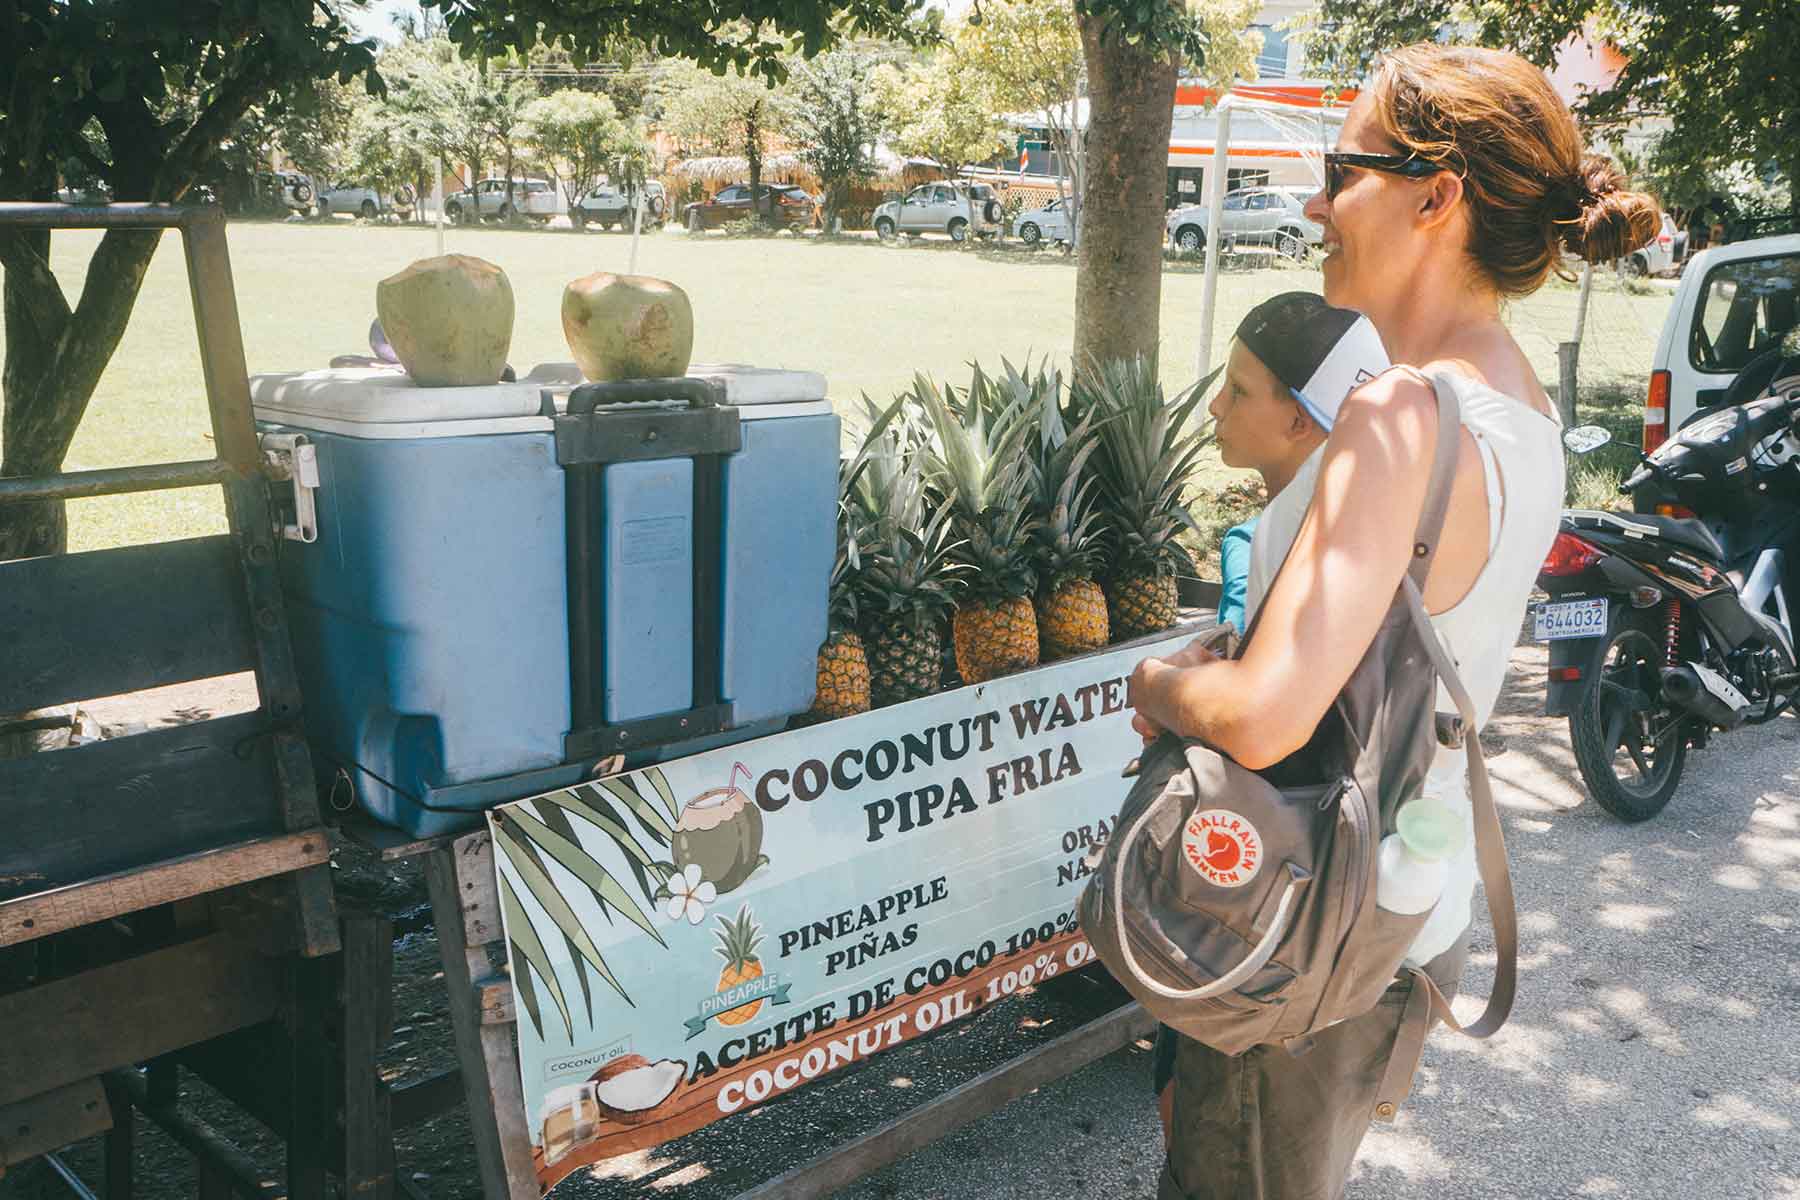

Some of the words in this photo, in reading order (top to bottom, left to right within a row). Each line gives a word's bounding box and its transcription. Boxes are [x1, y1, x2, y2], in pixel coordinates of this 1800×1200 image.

[1545, 608, 1602, 630] 644032
[755, 711, 999, 812] COCONUT
[864, 777, 978, 842] PIPA
[986, 742, 1083, 805] FRIA
[1057, 856, 1096, 887] NA
[778, 876, 949, 958] PINEAPPLE
[825, 923, 919, 977] PIÑAS
[687, 1001, 837, 1085] ACEITE
[847, 978, 897, 1022] DE
[904, 941, 996, 995] COCO
[1005, 910, 1079, 957] 100%
[702, 974, 777, 1014] PINEAPPLE
[551, 1054, 607, 1072] COCONUT
[609, 1045, 625, 1058] OIL
[717, 1018, 907, 1113] COCONUT
[915, 990, 973, 1032] OIL
[986, 952, 1059, 1002] 100%
